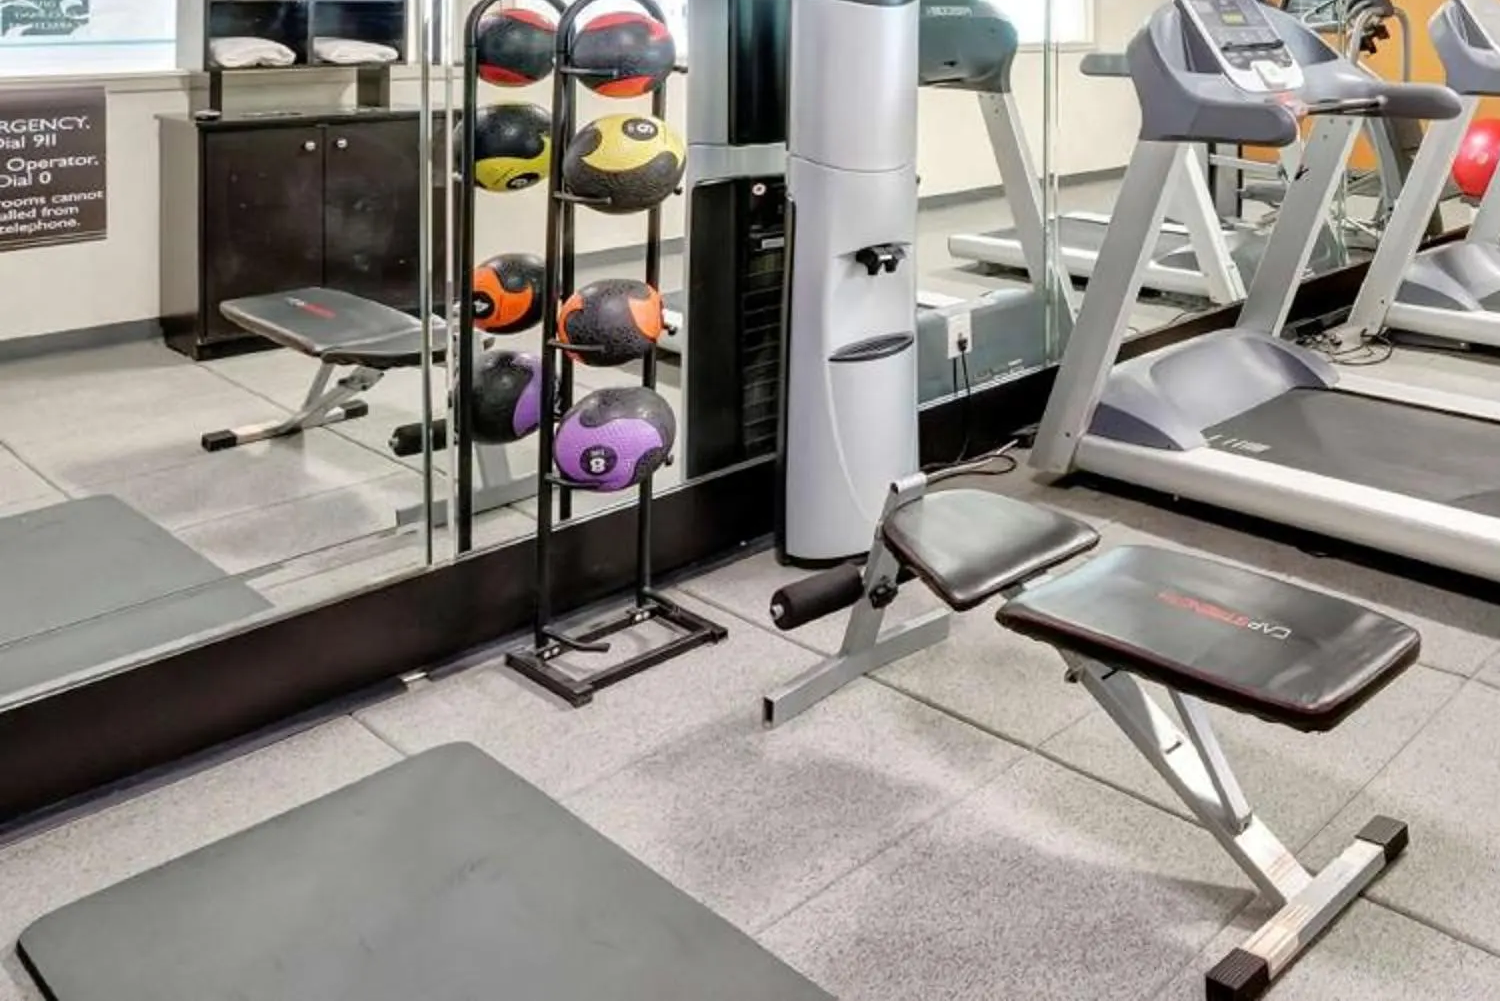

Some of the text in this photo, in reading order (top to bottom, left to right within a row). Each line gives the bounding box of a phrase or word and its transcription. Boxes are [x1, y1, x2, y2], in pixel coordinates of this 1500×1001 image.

[7, 156, 99, 174] Operator.
[0, 191, 104, 208] ooms cannot
[41, 206, 79, 217] from
[589, 458, 606, 474] 8
